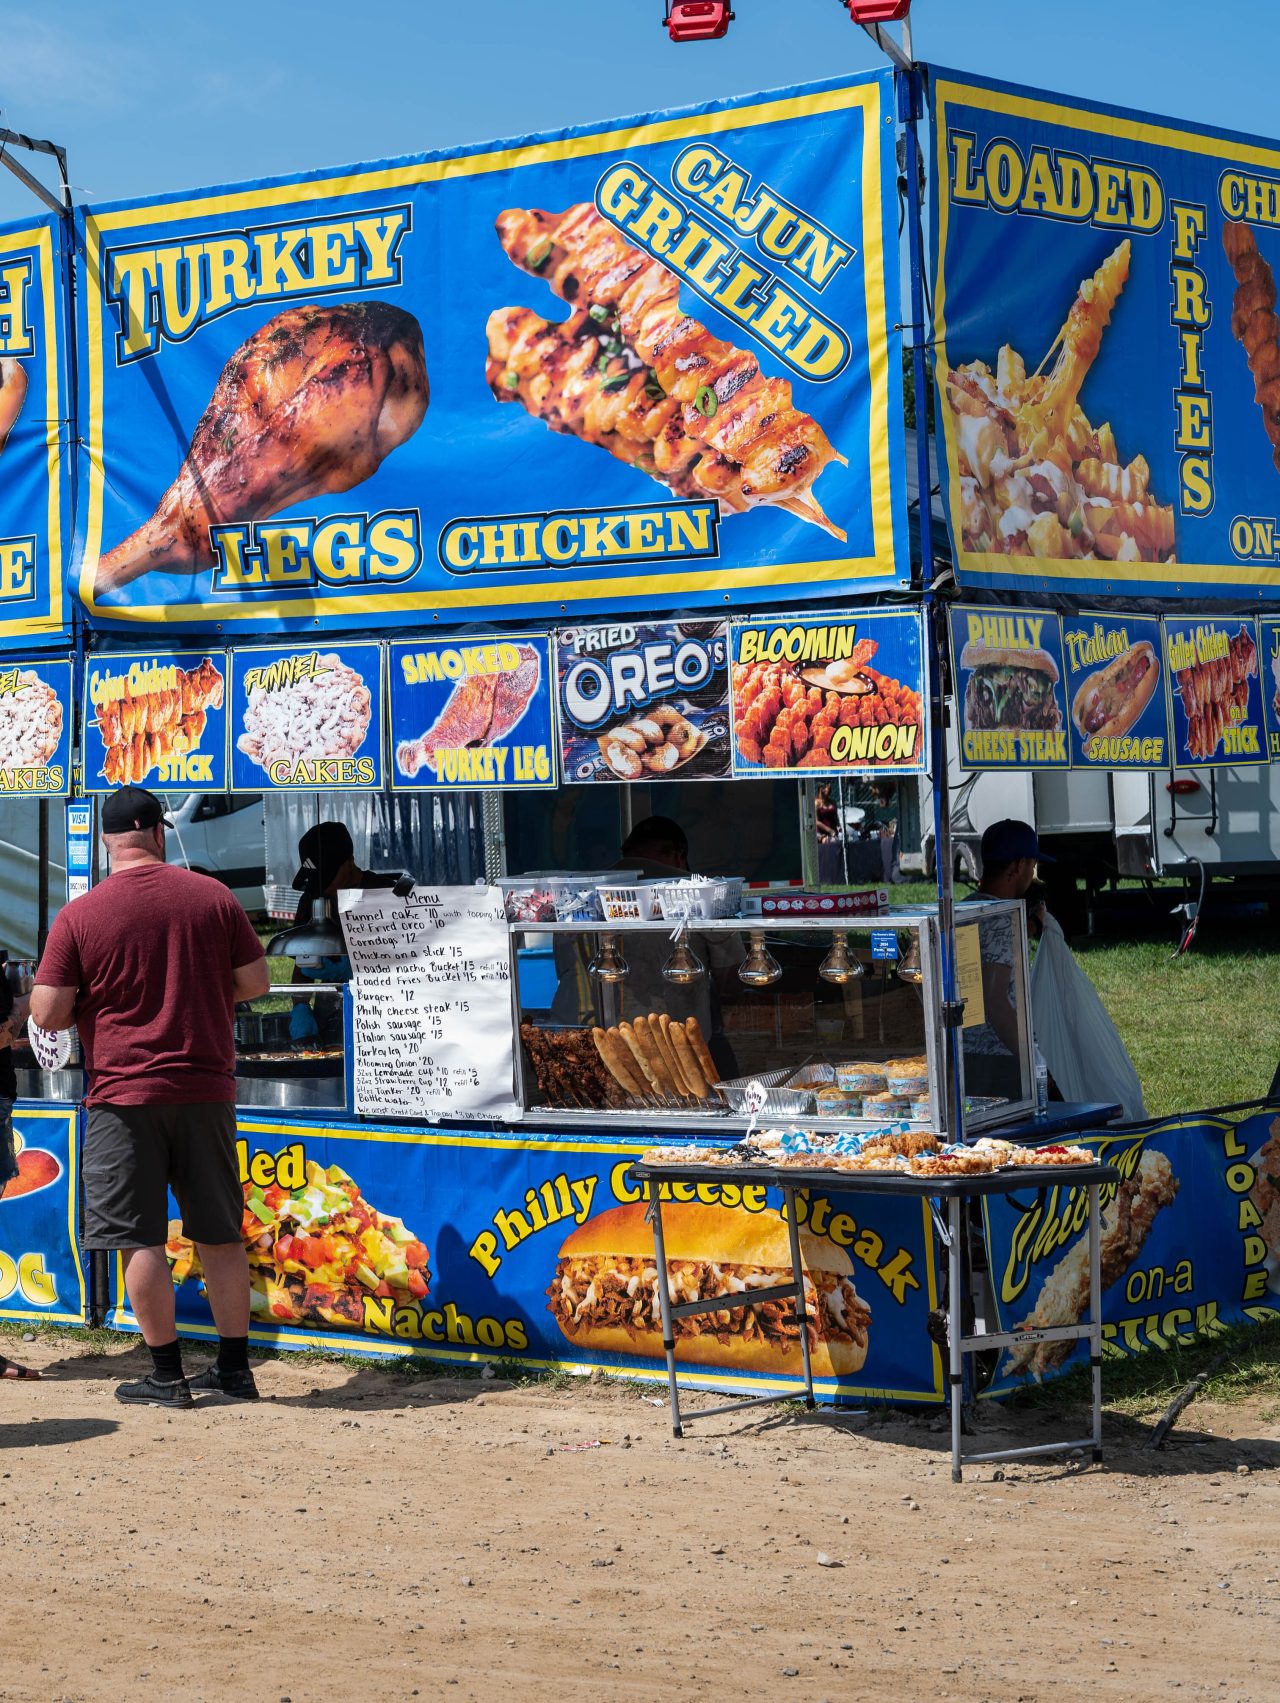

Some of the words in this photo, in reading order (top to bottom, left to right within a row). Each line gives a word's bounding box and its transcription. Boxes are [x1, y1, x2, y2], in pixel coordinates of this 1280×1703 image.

[949, 128, 1165, 236] LOADED
[671, 142, 855, 294] CAJUN
[104, 203, 413, 367] TURKEY
[595, 160, 852, 383] GRILLED
[1170, 198, 1215, 518] FRIES
[209, 507, 422, 593] LEGS
[437, 500, 720, 575] CHICKEN
[573, 626, 637, 654] FRIED
[738, 624, 856, 665] BLOOMIN
[966, 614, 1044, 650] PHILLY
[1195, 622, 1232, 664] Chicken
[127, 658, 178, 698] Chicken
[244, 651, 335, 697] FUNNEL
[400, 642, 522, 686] SMOKED
[563, 640, 727, 727] OREO'S
[829, 723, 918, 762] ONION
[963, 730, 1017, 763] CHEESE
[1018, 730, 1068, 762] STEAK
[1088, 735, 1165, 764] SAUSAGE
[1223, 726, 1261, 755] STICK
[158, 755, 215, 783] STICK
[269, 757, 376, 787] CAKES
[433, 748, 510, 783] TURKEY
[512, 745, 552, 782] LEG
[72, 813, 87, 825] VISA
[345, 910, 384, 922] Funnel
[392, 910, 420, 921] cake
[404, 893, 441, 905] Menu
[349, 933, 398, 950] Corndogs
[369, 922, 397, 933] Fried
[352, 950, 392, 961] Chicken
[395, 952, 409, 961] on
[411, 950, 418, 959] a
[423, 944, 446, 958] stick
[395, 964, 426, 974] nacho
[429, 961, 460, 973] Bucket
[356, 975, 392, 987] Loaded
[396, 975, 421, 985] Fries
[426, 971, 461, 984] Bucket
[356, 988, 395, 1006] Burgers
[356, 1003, 383, 1018] Philly
[387, 1003, 420, 1016] cheese
[423, 1001, 452, 1014] steak
[355, 1018, 381, 1031] Polish
[388, 1018, 423, 1033] sausage
[355, 1031, 387, 1044] Italian
[390, 1030, 427, 1046] sausage
[374, 1067, 414, 1078] Lemonade
[376, 1085, 405, 1097] Tanker
[468, 1173, 599, 1279] Philly
[1126, 1260, 1194, 1304] on-a
[361, 1295, 529, 1350] Nachos
[1101, 1301, 1230, 1360] STICK
